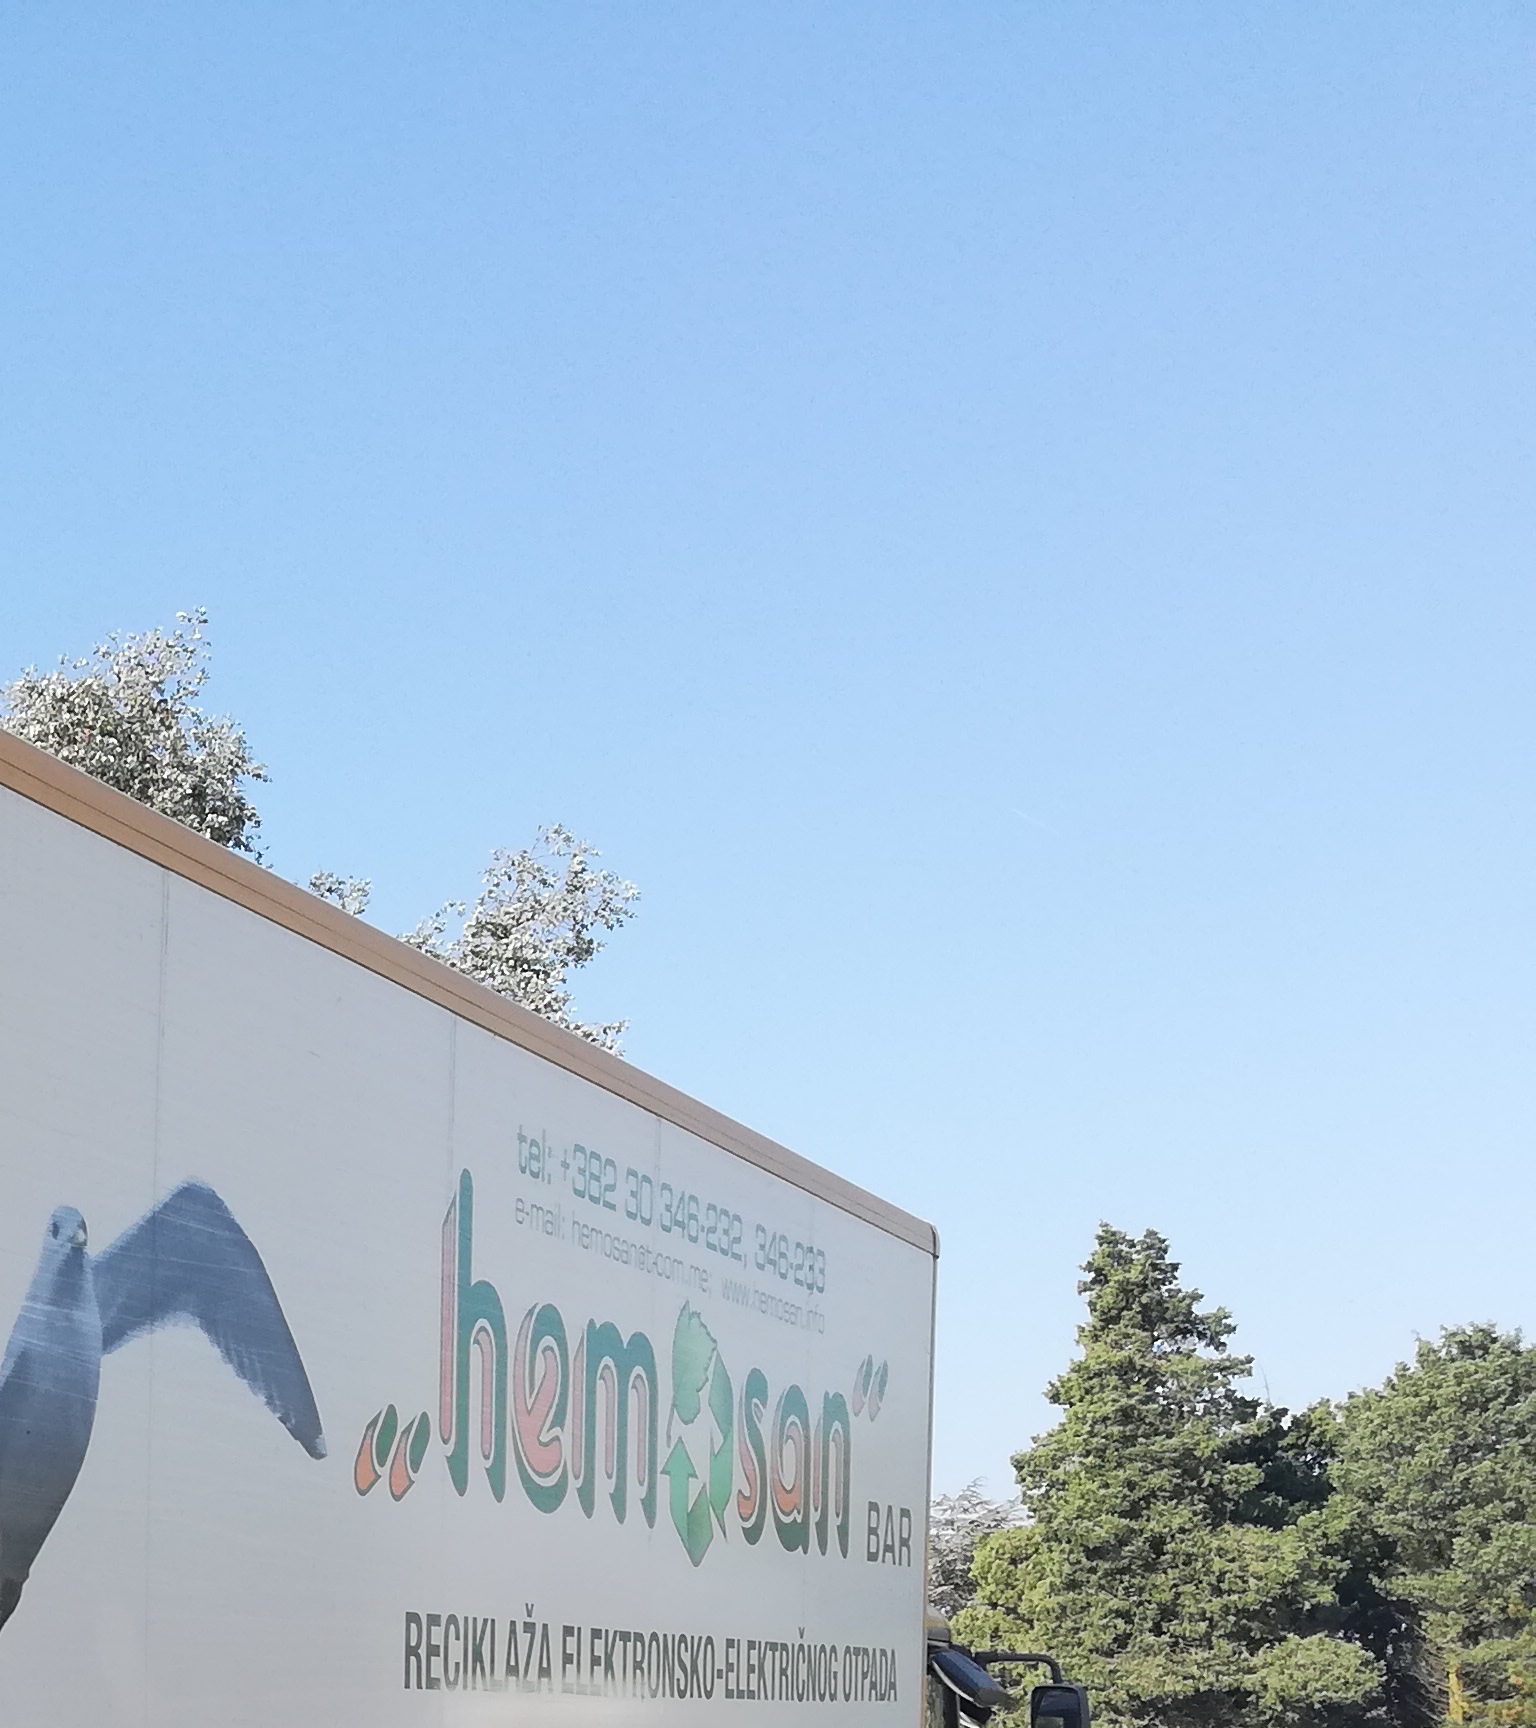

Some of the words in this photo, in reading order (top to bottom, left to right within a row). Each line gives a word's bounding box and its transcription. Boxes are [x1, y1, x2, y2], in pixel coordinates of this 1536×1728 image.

[516, 1124, 552, 1185] tel:
[560, 1143, 618, 1212] +382
[624, 1166, 654, 1227] 30
[866, 1500, 913, 1567] BAR
[404, 1603, 554, 1694] RECIKLAŽA
[842, 1644, 898, 1702] OTPADA
